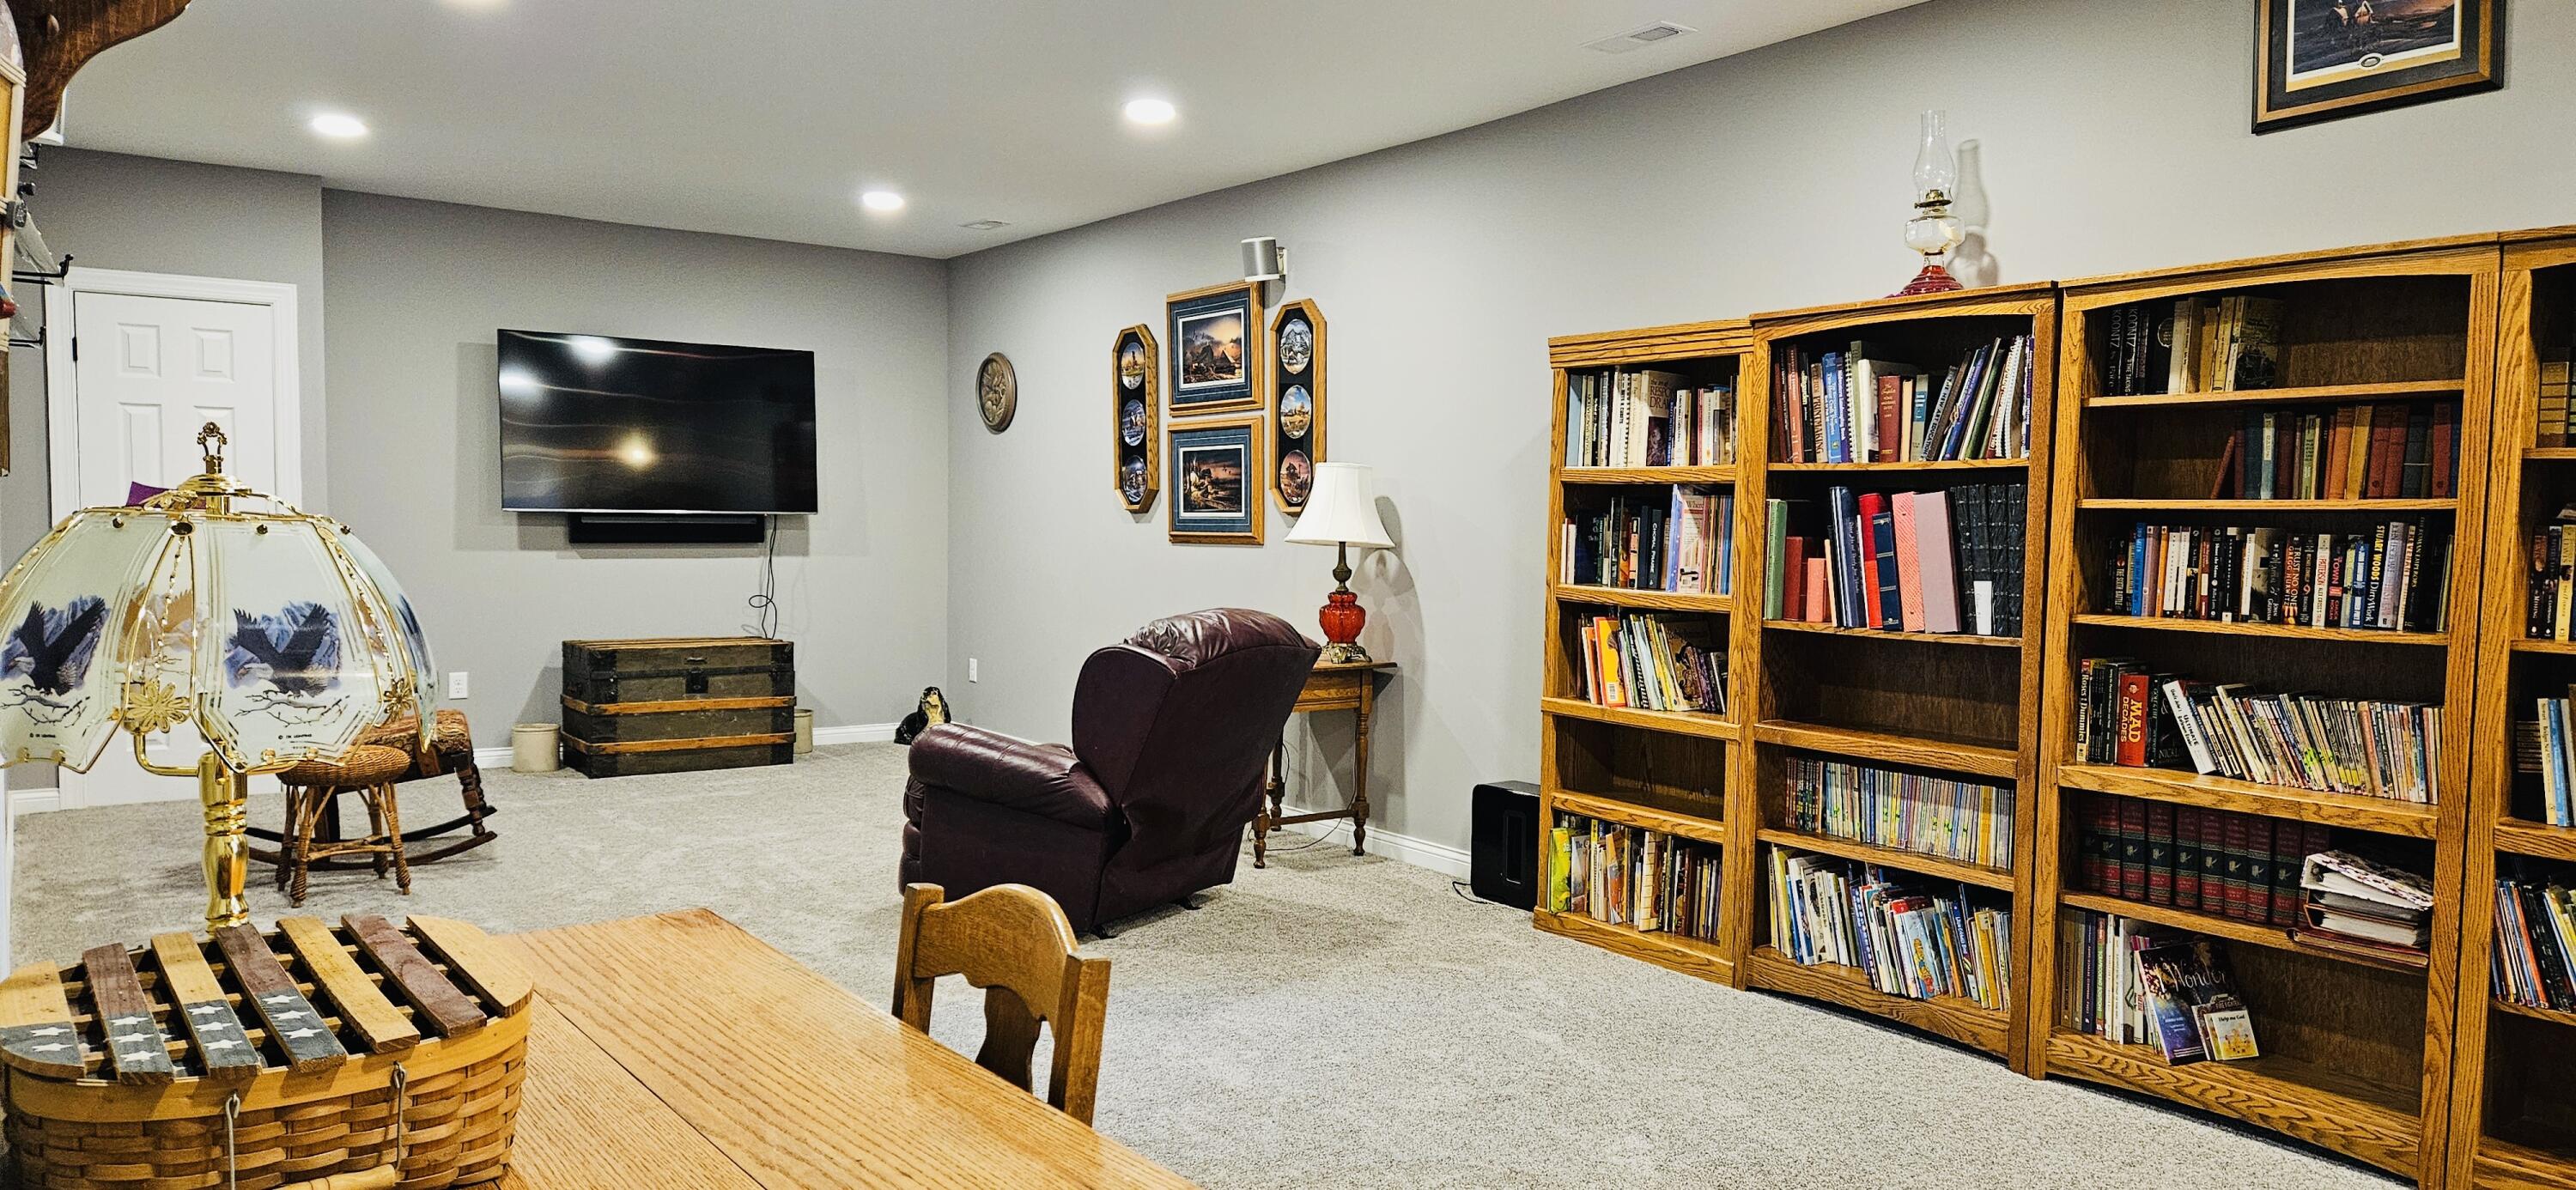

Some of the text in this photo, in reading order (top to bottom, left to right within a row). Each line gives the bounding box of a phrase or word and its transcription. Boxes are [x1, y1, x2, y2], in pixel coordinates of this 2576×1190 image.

[2110, 309, 2121, 347] KOONTZ
[2126, 308, 2137, 347] KOONTZ
[1814, 396, 1824, 453] PRINTMAKING
[1923, 422, 1937, 455] EDUCATION
[2374, 525, 2385, 551] STUART
[2293, 547, 2301, 572] TRUST
[2317, 558, 2326, 586] PATTERSON
[2331, 557, 2340, 584] TOWN
[2371, 554, 2382, 580] WOODS
[2293, 573, 2300, 586] NO
[2078, 702, 2087, 741] Dummies
[2121, 696, 2129, 742] DECADES
[2129, 699, 2142, 743] MAD
[2184, 714, 2199, 747] ULTIMATE
